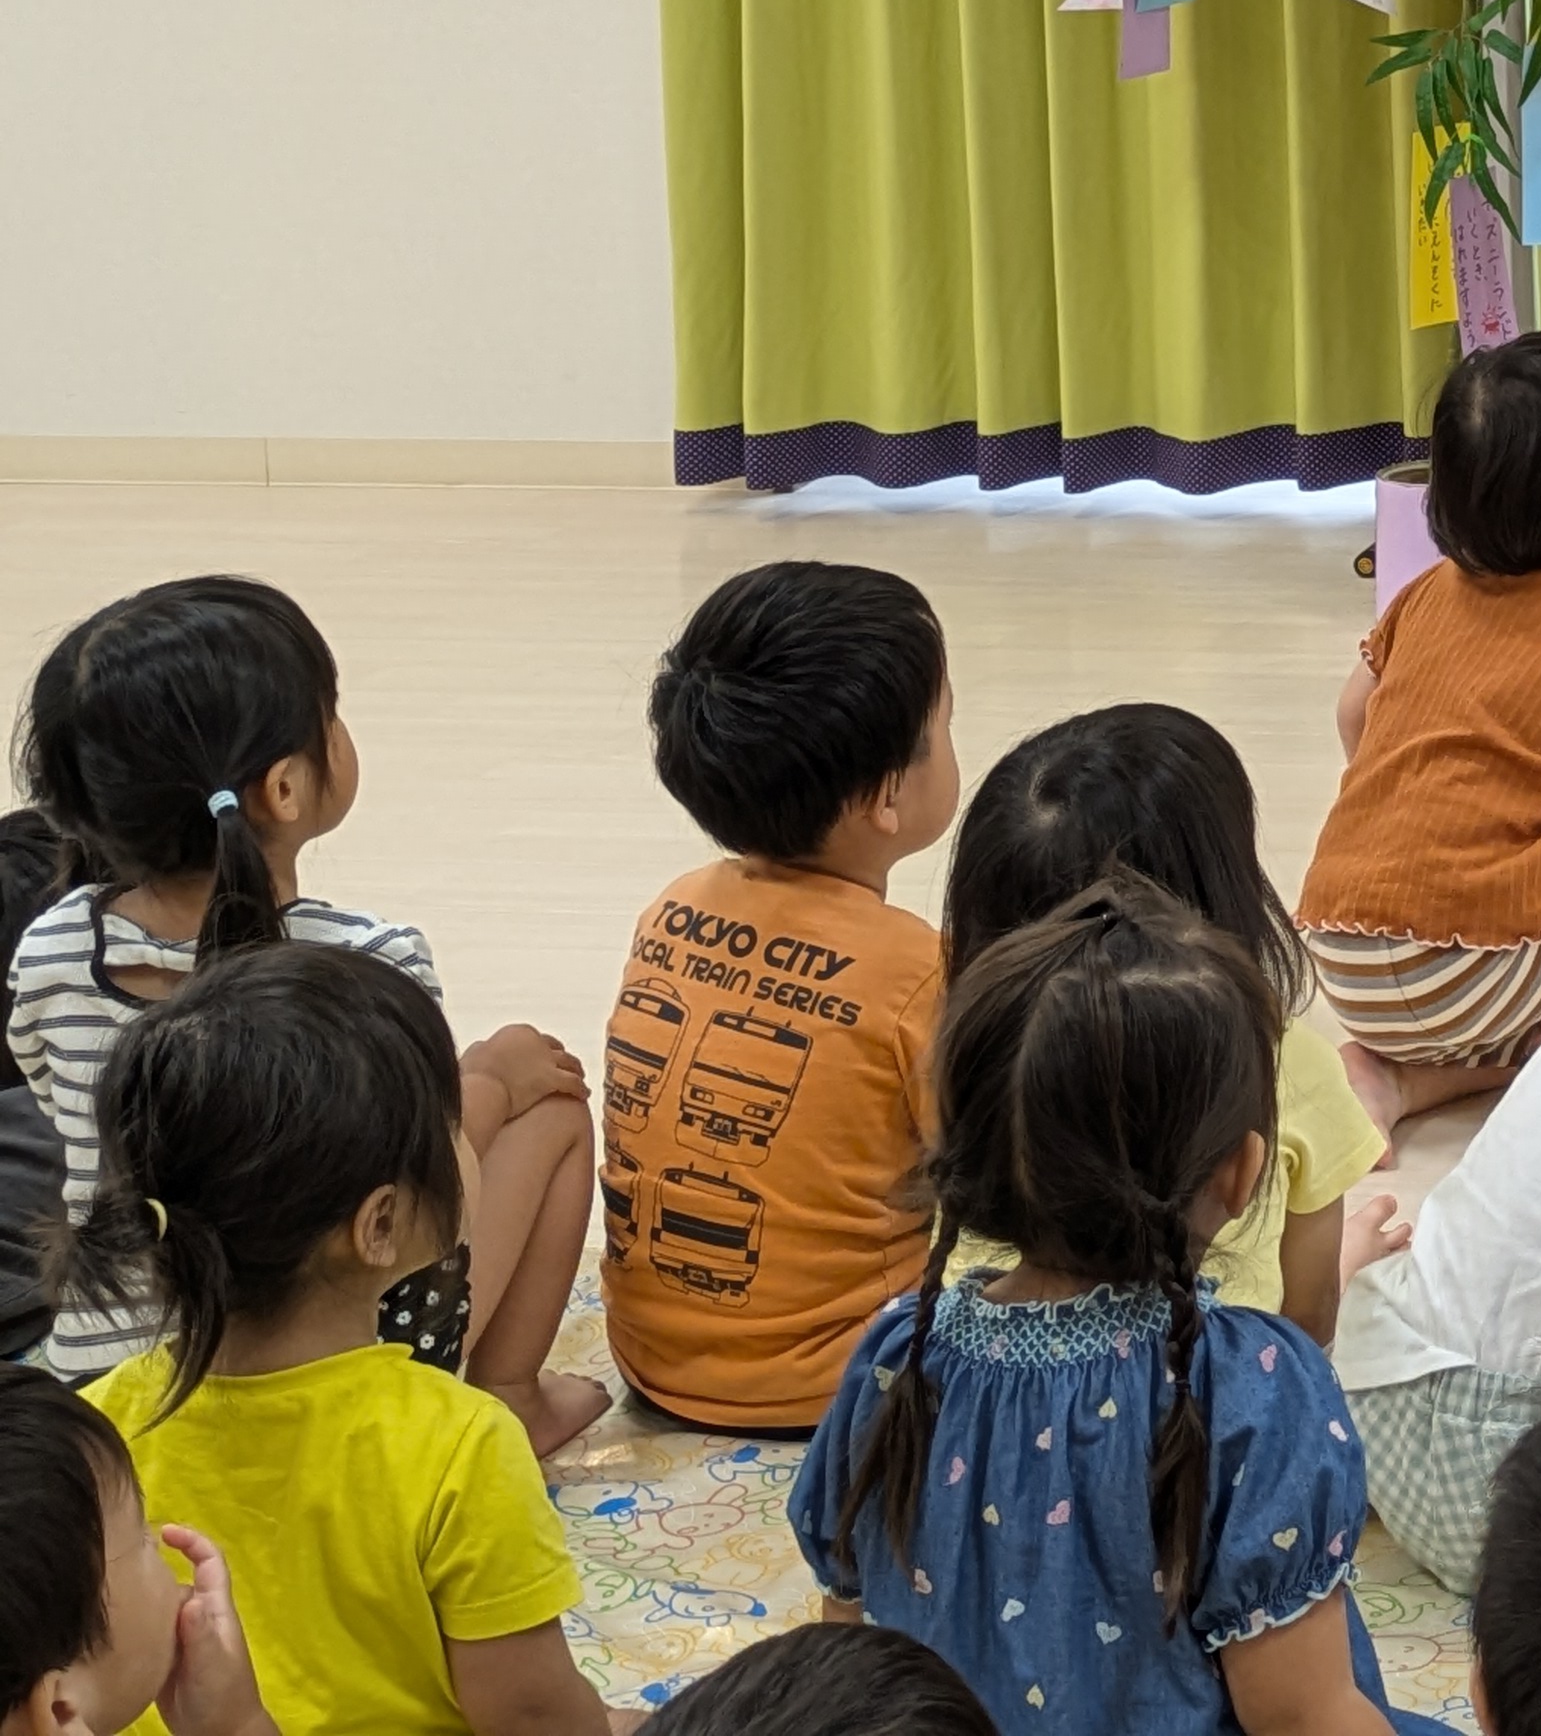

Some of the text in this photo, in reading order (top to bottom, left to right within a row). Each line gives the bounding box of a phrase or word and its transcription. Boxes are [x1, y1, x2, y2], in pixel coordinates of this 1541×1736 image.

[1481, 200, 1513, 341] ズニーランド
[633, 935, 862, 1026] OCAL TRAIN SERIES
[652, 900, 856, 981] TOKYO CITY
